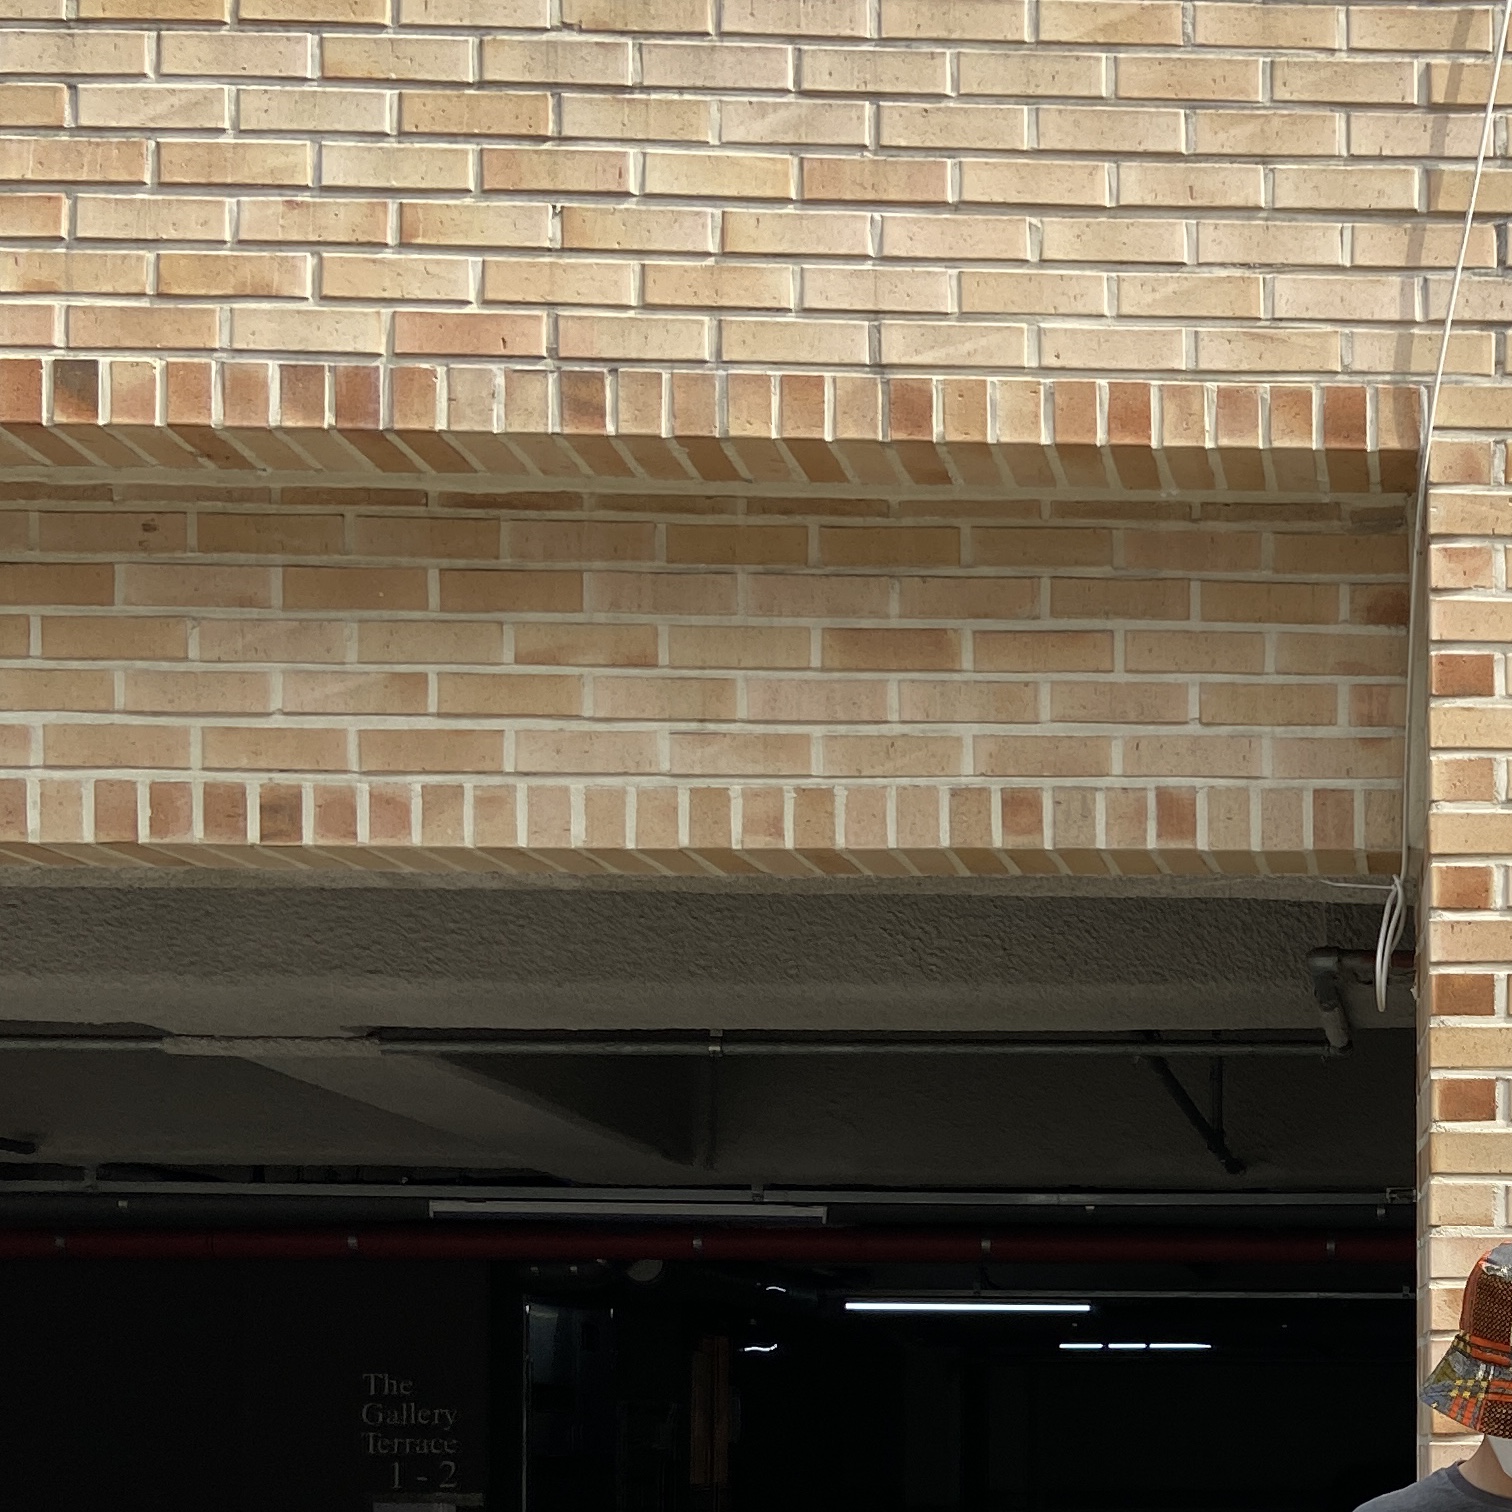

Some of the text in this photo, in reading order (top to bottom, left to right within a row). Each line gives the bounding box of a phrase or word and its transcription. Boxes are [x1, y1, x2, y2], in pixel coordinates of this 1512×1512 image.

[362, 1373, 413, 1396] The
[361, 1402, 458, 1431] Gallery
[361, 1431, 459, 1454] Terrace
